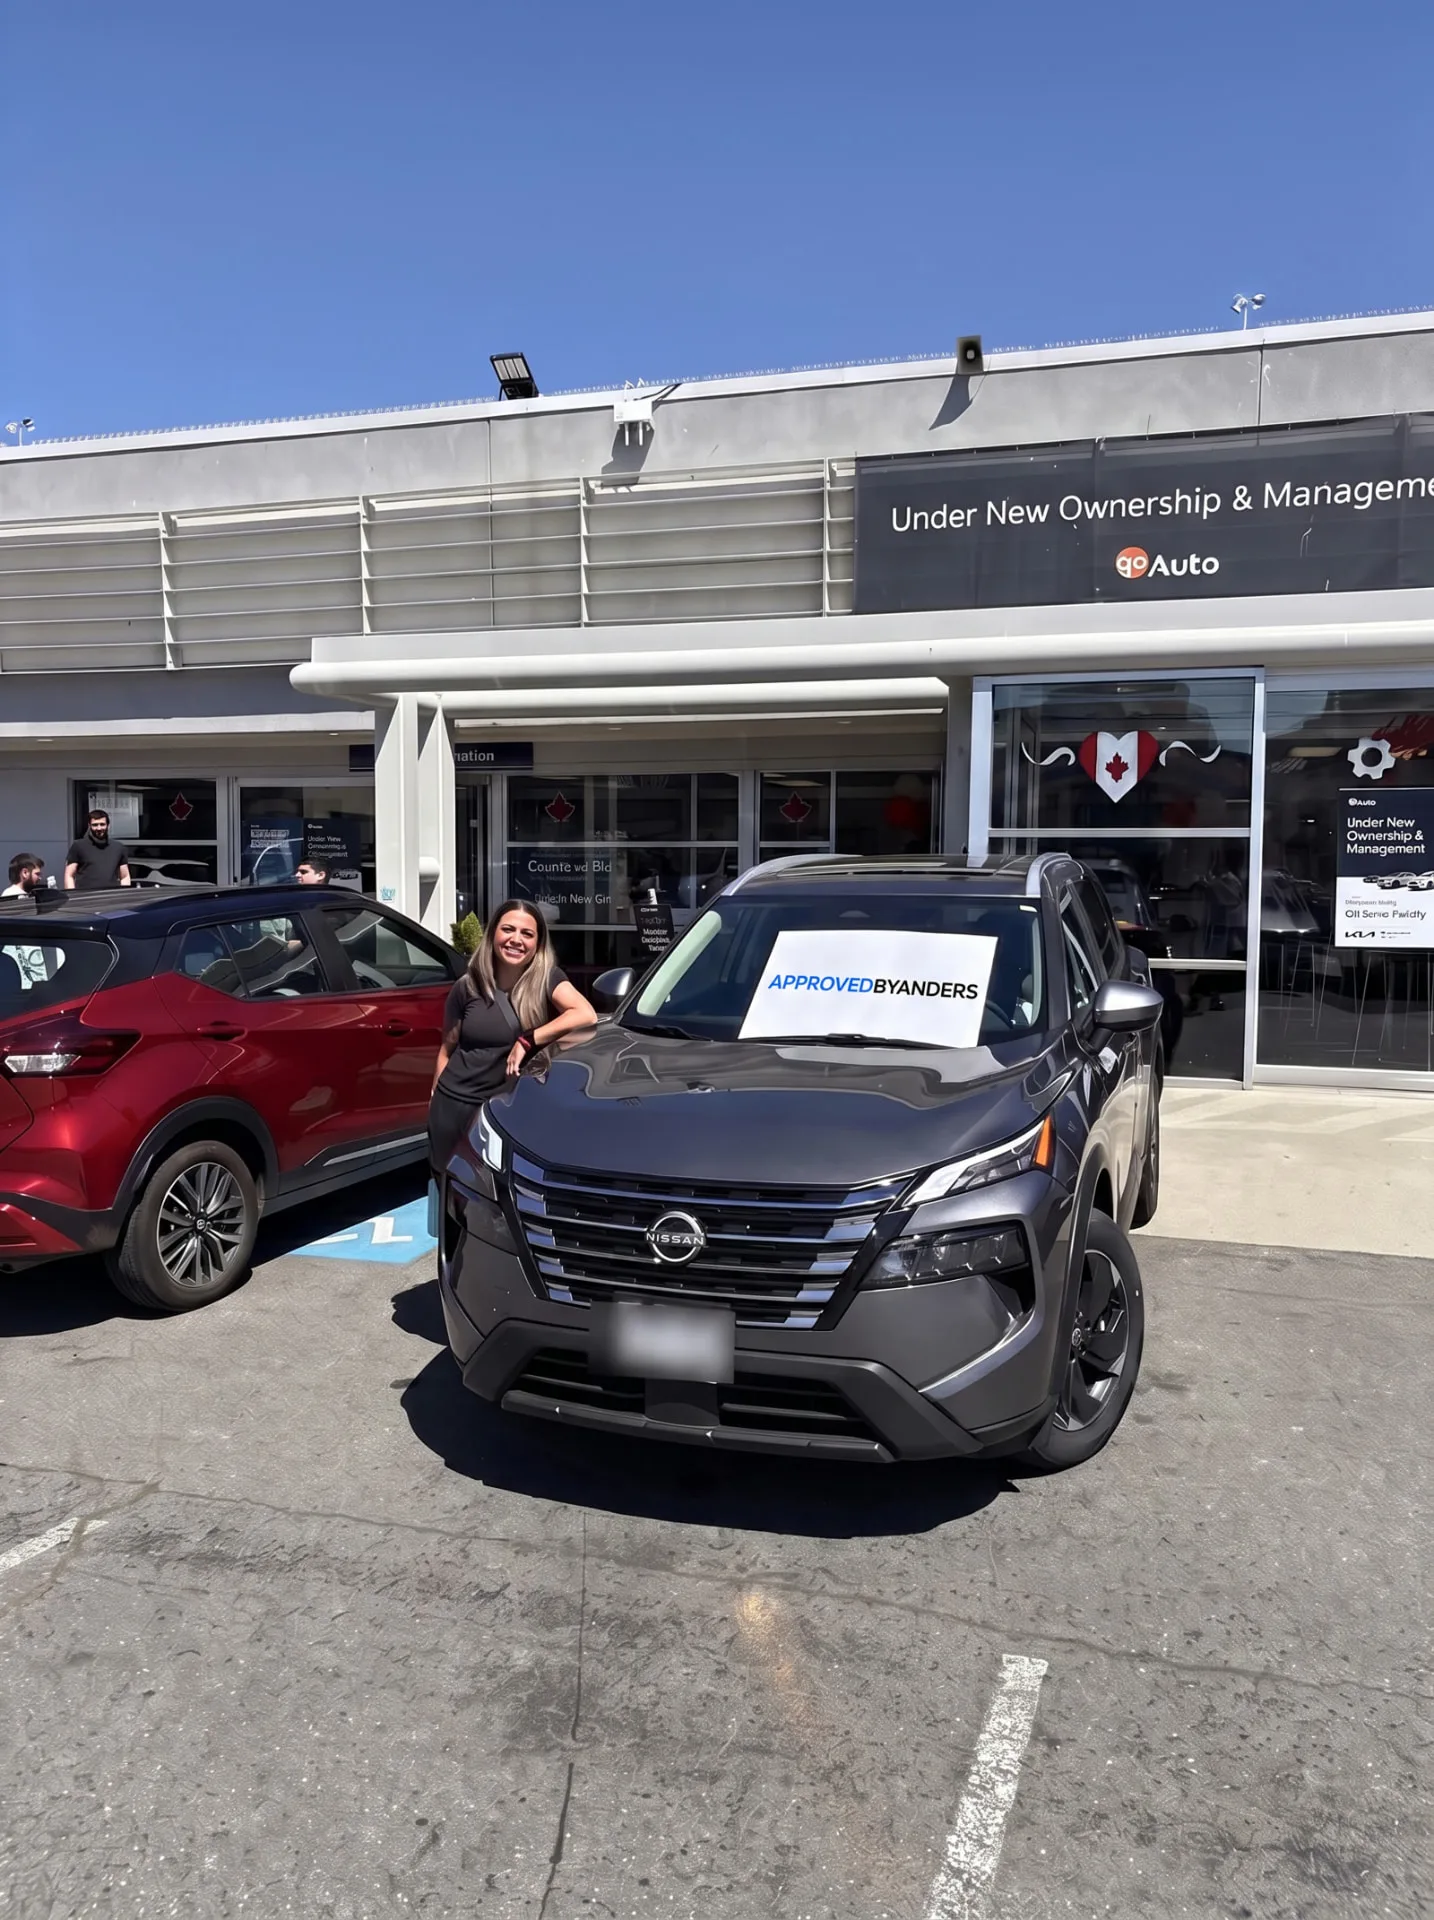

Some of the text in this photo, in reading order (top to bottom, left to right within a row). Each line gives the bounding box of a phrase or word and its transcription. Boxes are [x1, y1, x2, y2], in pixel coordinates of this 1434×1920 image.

[892, 503, 978, 532] Under
[986, 500, 1050, 526] New
[1059, 487, 1221, 521] Ownership
[1232, 485, 1253, 511] &
[1347, 816, 1416, 828] Under New
[1346, 829, 1424, 844] Ownership &
[1346, 843, 1427, 858] Management
[646, 1232, 704, 1245] NISSAN
